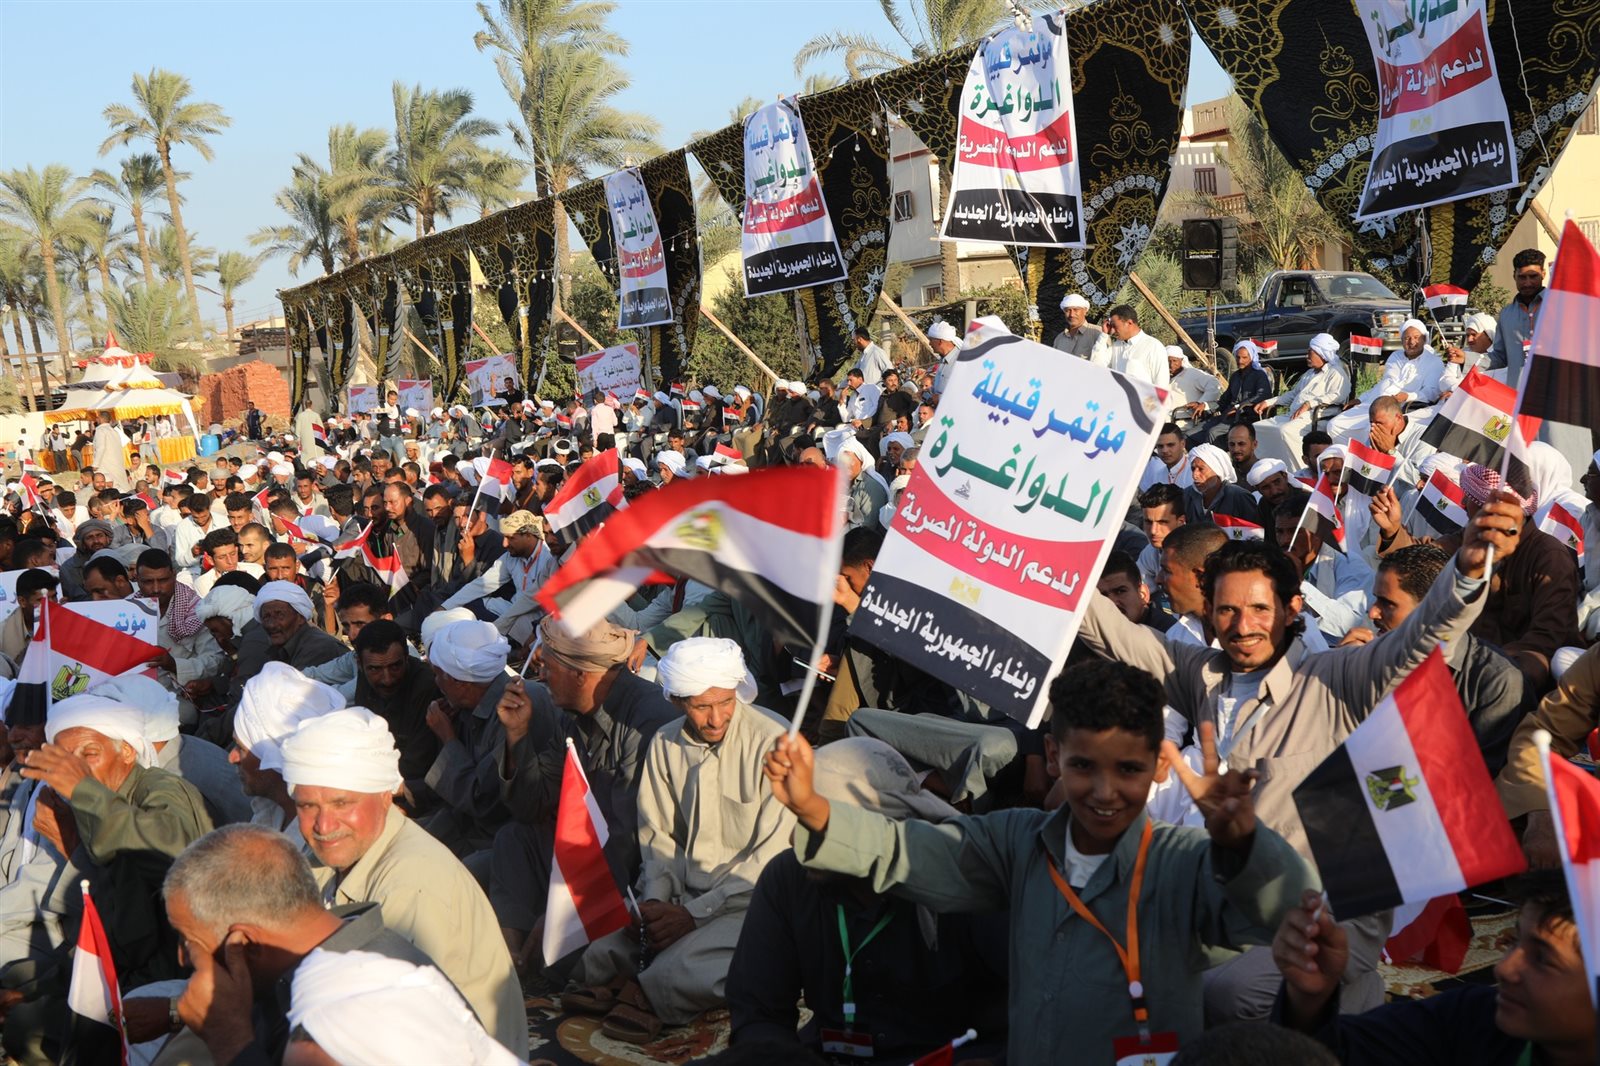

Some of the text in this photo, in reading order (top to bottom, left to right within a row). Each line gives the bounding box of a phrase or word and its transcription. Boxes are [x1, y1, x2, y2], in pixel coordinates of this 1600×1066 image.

[1440, 47, 1484, 88] لدعم
[969, 77, 1061, 122] الدواغرة
[959, 135, 1004, 159] المصرية
[1039, 138, 1068, 162] لدعم
[1470, 138, 1505, 169] وبناء
[1404, 146, 1469, 188] الجمهورية
[768, 203, 799, 222] الدولة
[1046, 206, 1074, 229] وبناء
[746, 251, 837, 282] وبناء الجمهورية الجديدة
[971, 359, 1126, 459] مؤتمر قبيلة
[929, 414, 1114, 529] الدواغرة
[900, 493, 1081, 596] لدعم الدولة المصرية
[113, 611, 147, 636] مؤتم
[861, 584, 1037, 701] وبناء الجمهورية الجديدة
